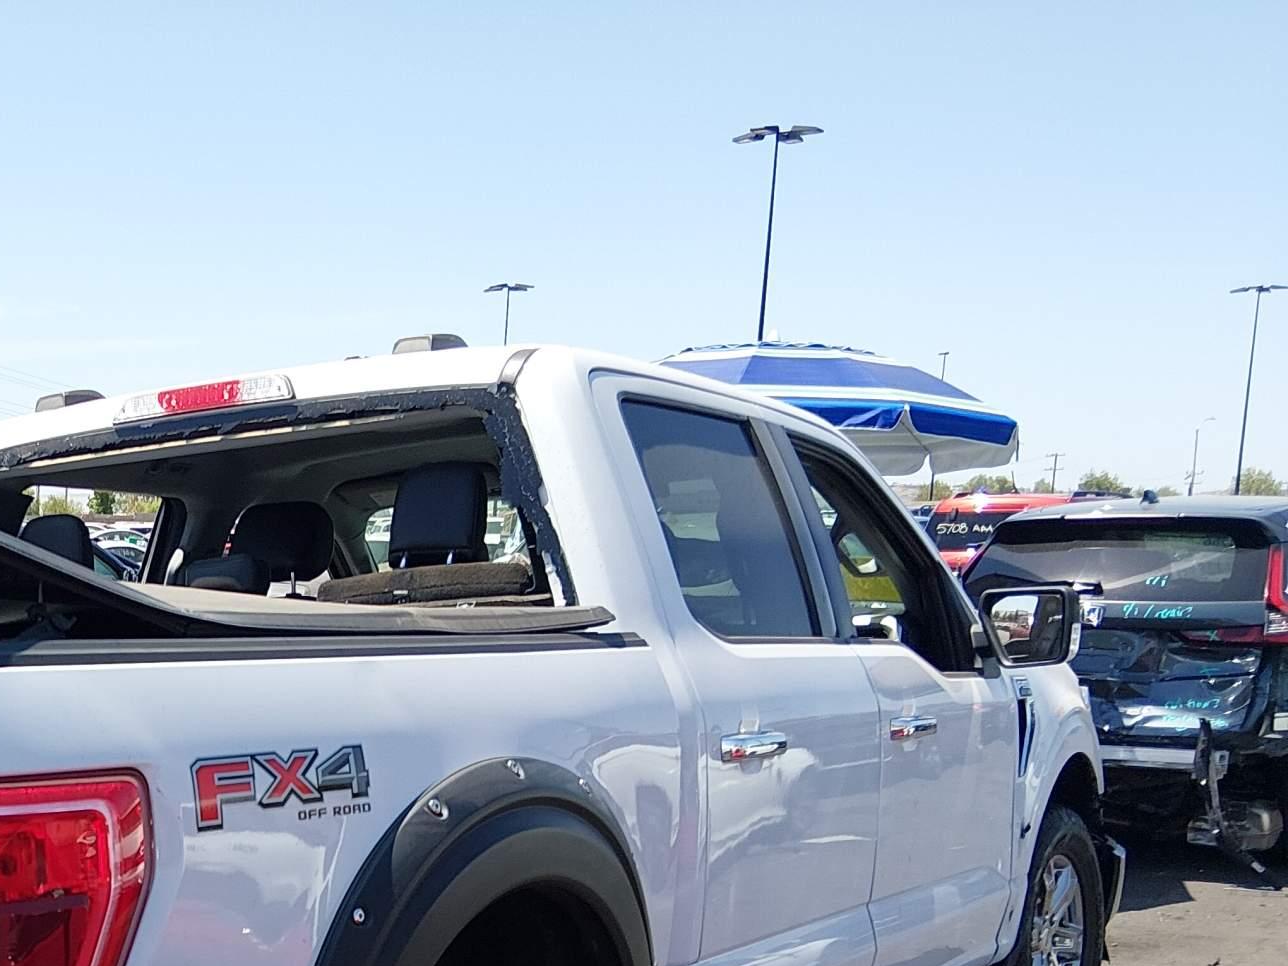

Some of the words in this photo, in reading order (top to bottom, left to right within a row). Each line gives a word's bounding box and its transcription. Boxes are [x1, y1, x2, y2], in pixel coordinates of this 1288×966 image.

[936, 522, 969, 535] 5708
[190, 743, 370, 832] FX4
[297, 808, 328, 821] OFF
[333, 802, 372, 817] ROAD
